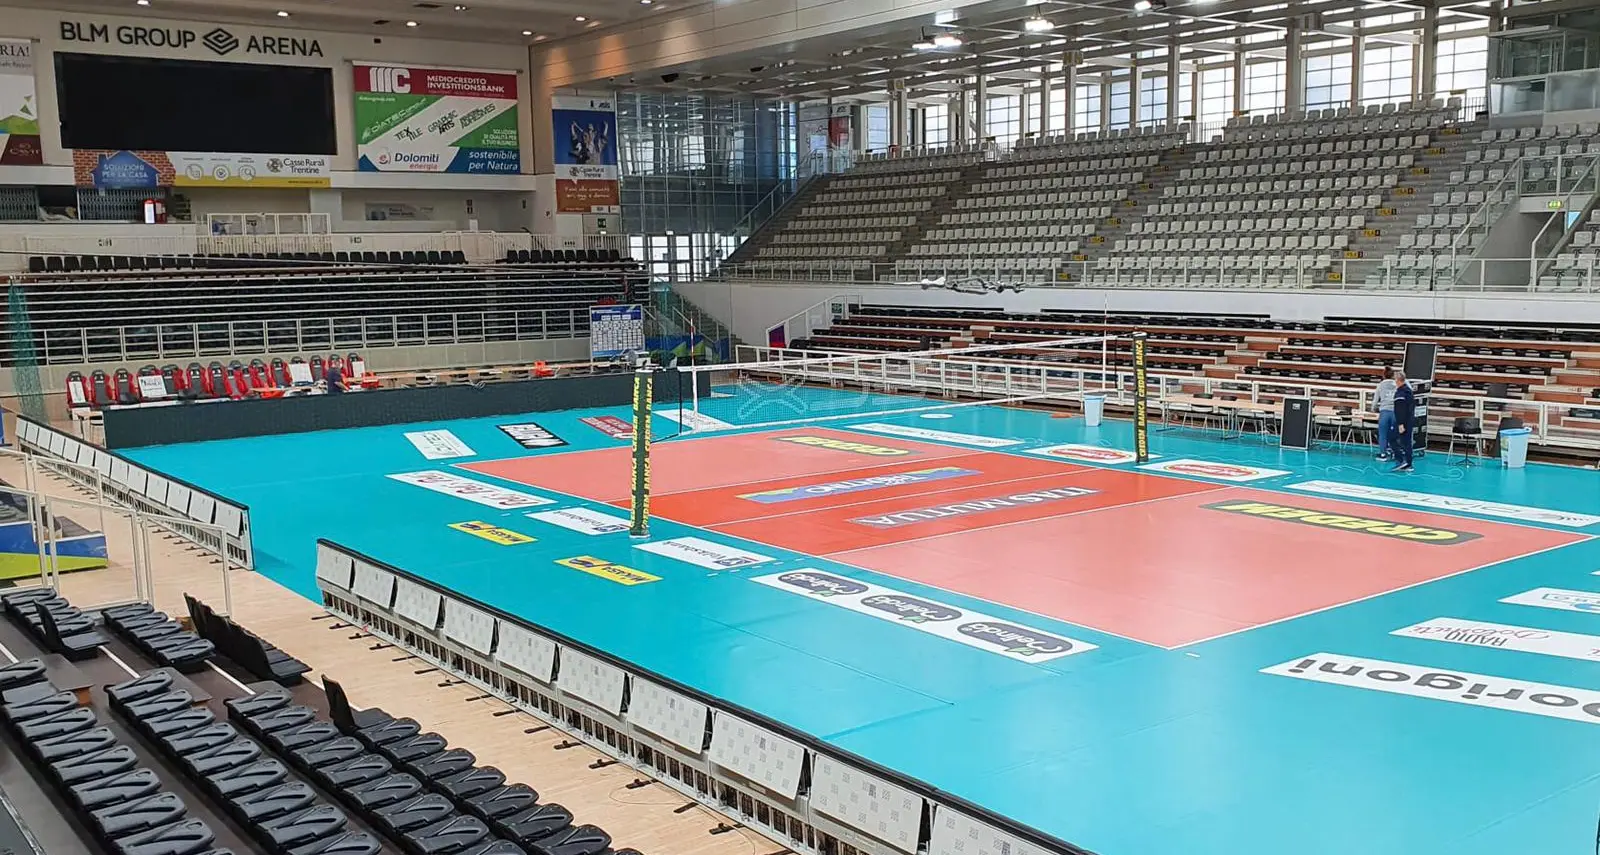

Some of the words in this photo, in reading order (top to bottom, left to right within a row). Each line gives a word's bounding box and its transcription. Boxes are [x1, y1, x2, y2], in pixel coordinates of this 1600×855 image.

[60, 21, 109, 43] BLM
[116, 25, 196, 49] GROUP
[246, 35, 324, 58] ARENA
[426, 74, 487, 86] MEDIOCREDITO
[426, 81, 506, 94] INVESTITIONSBANK
[427, 109, 459, 134] GRAPHIC
[438, 120, 455, 136] ARTS
[283, 158, 304, 168] Casse
[305, 158, 325, 168] Rurali
[394, 152, 440, 164] Dolomiti
[468, 150, 518, 161] sostenibile
[290, 166, 320, 175] Trentine
[408, 162, 439, 172] energia
[468, 161, 485, 172] per
[486, 160, 518, 172] Natura
[1135, 340, 1143, 366] BANCA
[1008, 486, 1093, 503] ITAS
[858, 498, 1006, 526] MUTUA
[1217, 502, 1459, 540] CREDEM
[661, 541, 727, 561] Volksbank
[791, 572, 861, 595] Melinda
[875, 595, 953, 621] Melinda
[970, 621, 1064, 653] Melinda
[1446, 628, 1507, 648] RADIO
